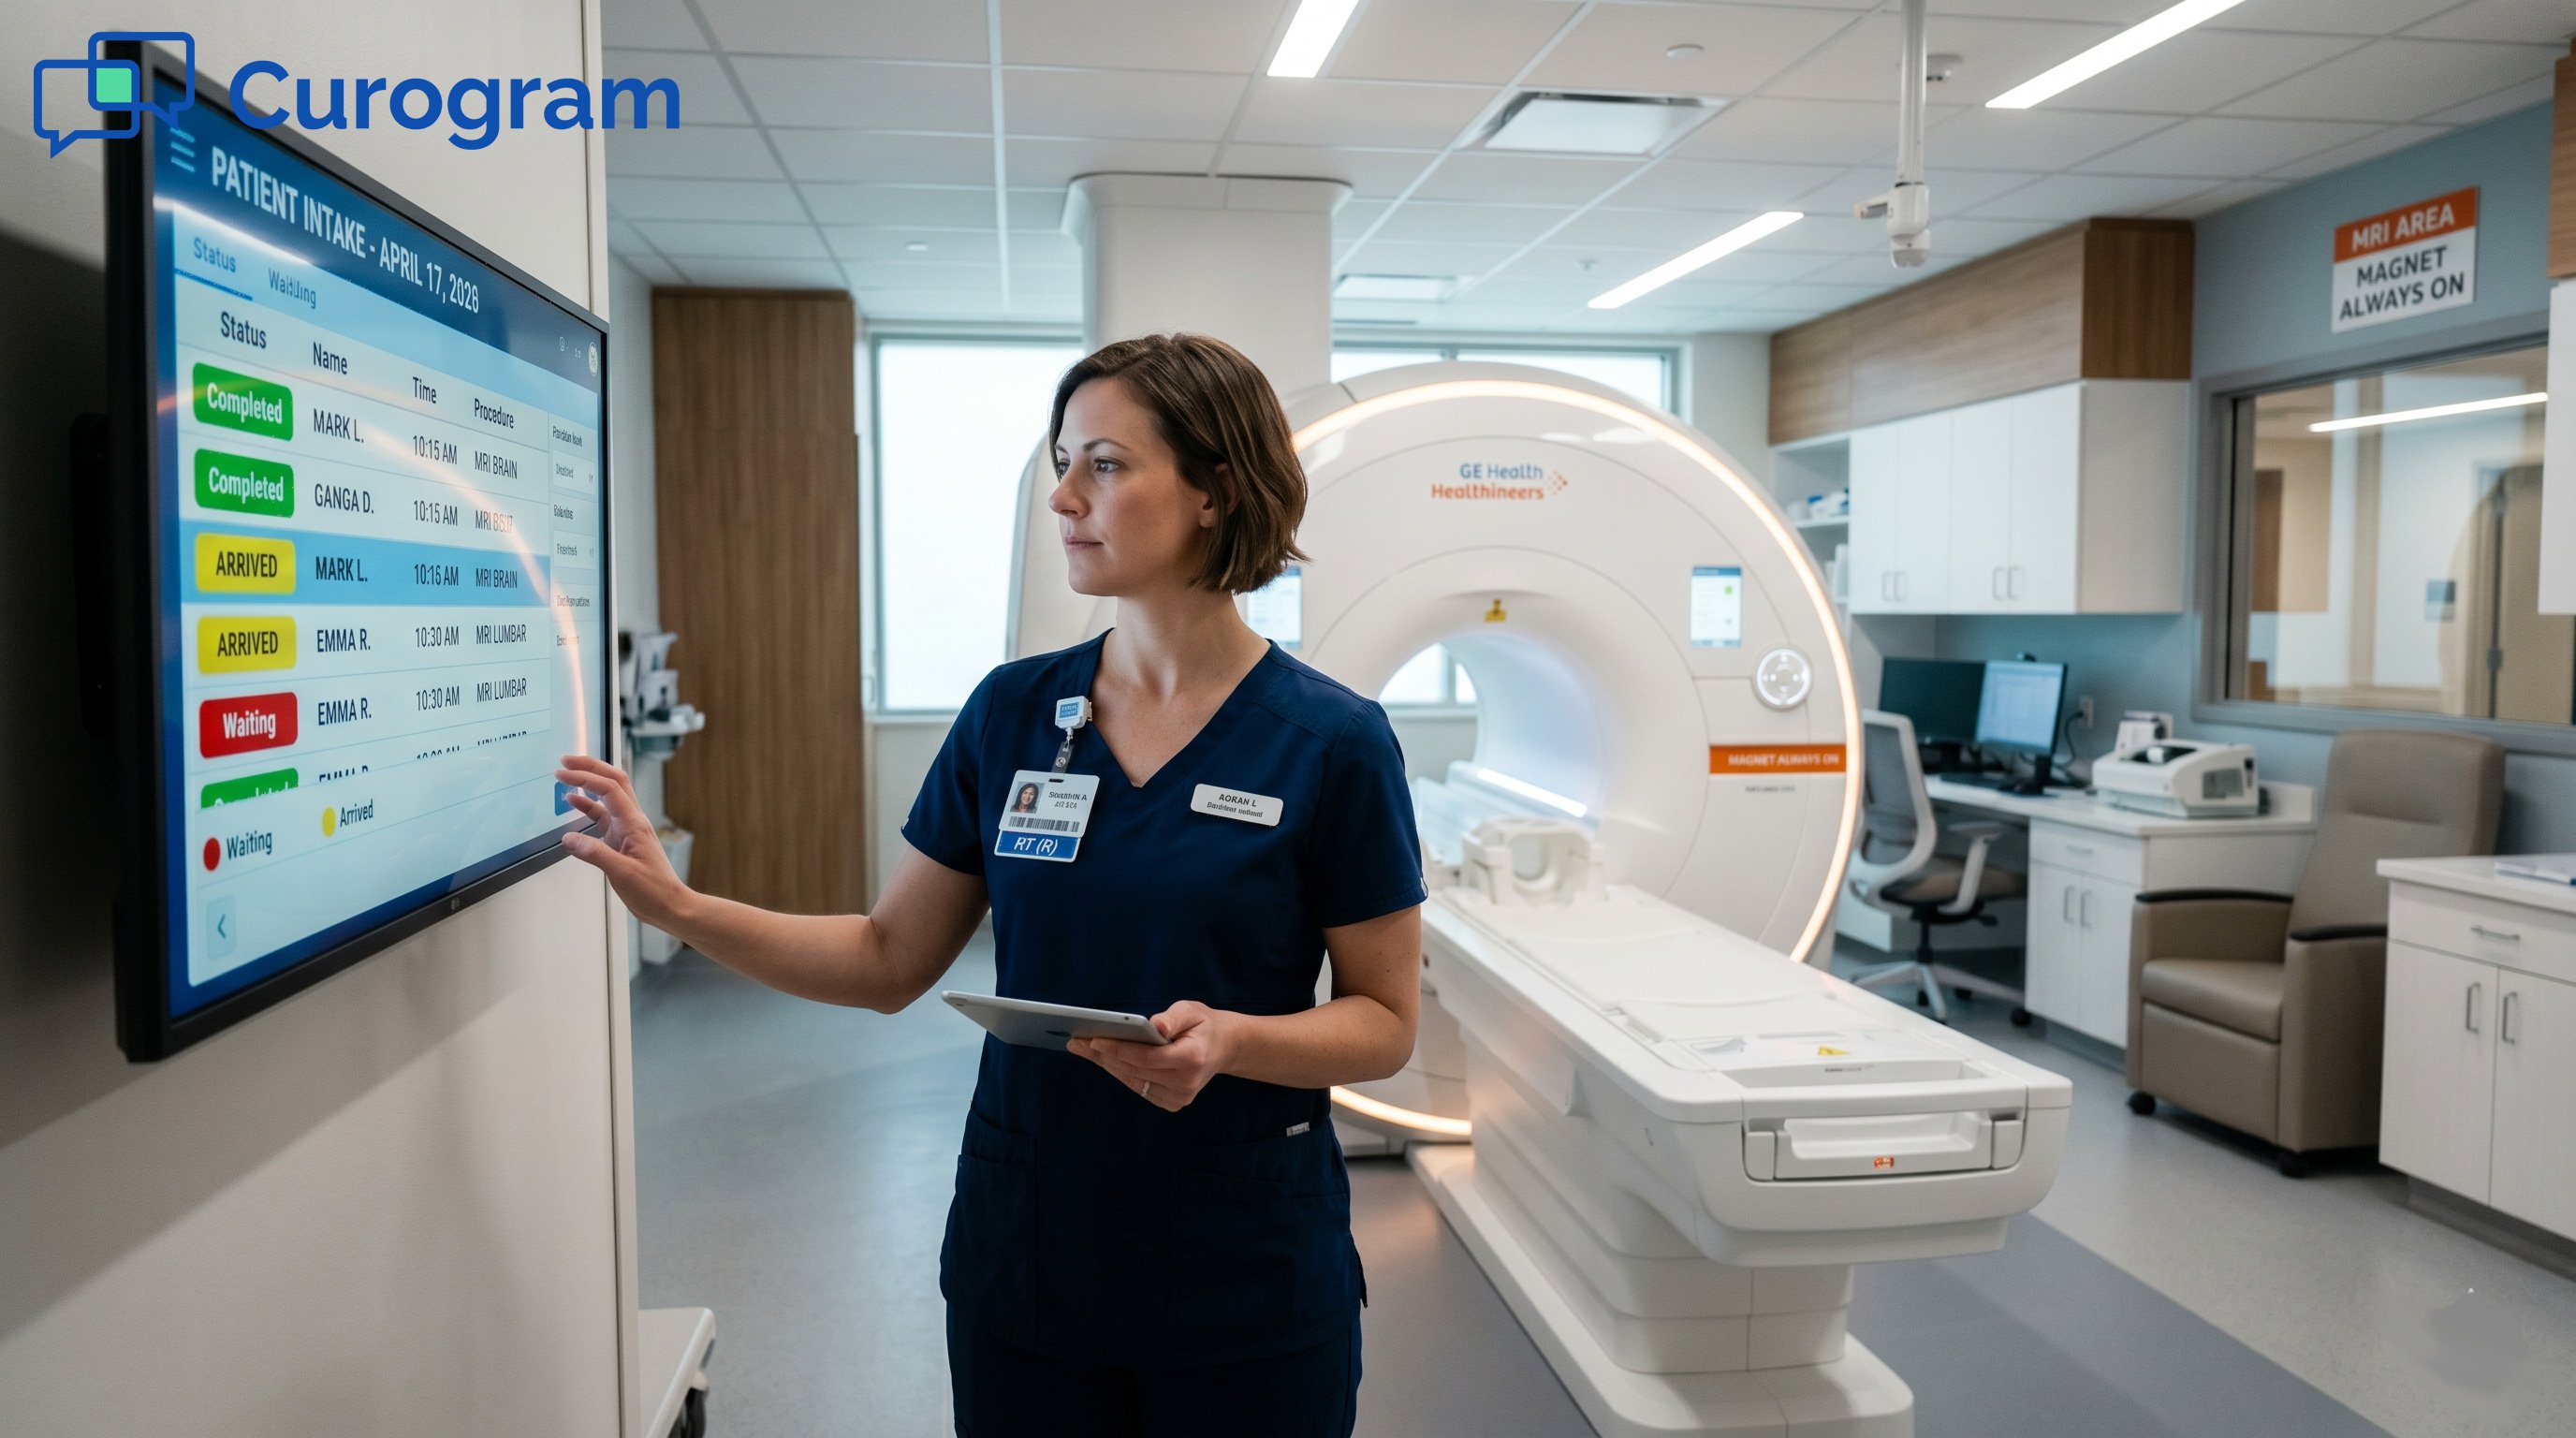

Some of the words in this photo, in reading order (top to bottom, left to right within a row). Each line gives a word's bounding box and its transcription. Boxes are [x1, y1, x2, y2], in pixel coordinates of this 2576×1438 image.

[212, 145, 299, 225] PATIENT
[303, 194, 366, 259] INTAKE
[379, 236, 423, 286] APRIL
[426, 261, 446, 304] 17,
[2352, 221, 2390, 252] MRI
[2395, 203, 2454, 240] AREA
[193, 236, 237, 273] Status
[2357, 245, 2448, 287] MAGNET
[2340, 282, 2424, 319] ALWAYS
[2431, 272, 2465, 300] ON
[220, 310, 267, 349] Status
[313, 341, 348, 375] Name
[412, 376, 437, 404] Time
[474, 397, 515, 430] Procedure
[207, 381, 283, 424] Completed
[313, 407, 351, 441] MARK
[354, 418, 365, 444] L.
[413, 434, 441, 462] 10:15
[442, 442, 458, 465] AM
[475, 450, 491, 474] MRI
[493, 455, 518, 480] BRAIN
[1460, 463, 1482, 479] GE
[1486, 463, 1544, 480] Health
[208, 465, 284, 505] Completed
[314, 483, 360, 512] GANGA
[362, 491, 375, 515] D.
[413, 500, 441, 524] 10:15
[442, 505, 459, 526] AM
[475, 509, 491, 531] MRI
[1431, 483, 1544, 500] Healthineers
[215, 550, 278, 579] ARRIVED
[315, 556, 354, 581] MARK
[357, 559, 369, 582] L.
[444, 565, 459, 587] AM
[476, 568, 491, 588] MRI
[493, 568, 518, 589] BRAIN
[217, 630, 279, 657] ARRIVED
[316, 628, 357, 653] EMMA
[359, 628, 372, 651] R.
[415, 626, 442, 648] 10:30
[444, 626, 460, 646] AM
[476, 624, 491, 645] MRI
[493, 624, 527, 644] LUMBAR
[223, 709, 276, 740] Waiting
[317, 698, 358, 726] EMMA
[360, 697, 373, 720] R.
[416, 687, 443, 712] 10:30
[445, 685, 461, 708] AM
[476, 682, 492, 703] MRI
[494, 678, 527, 700] LUMBAR
[1728, 754, 1775, 767] MAGNET
[1777, 753, 1821, 766] ALWAYS
[1822, 753, 1839, 766] ON
[339, 799, 373, 829] Arrived
[1251, 800, 1257, 808] L
[226, 829, 272, 860] Waiting
[1014, 836, 1036, 852] RT
[1036, 838, 1059, 857] (R)
